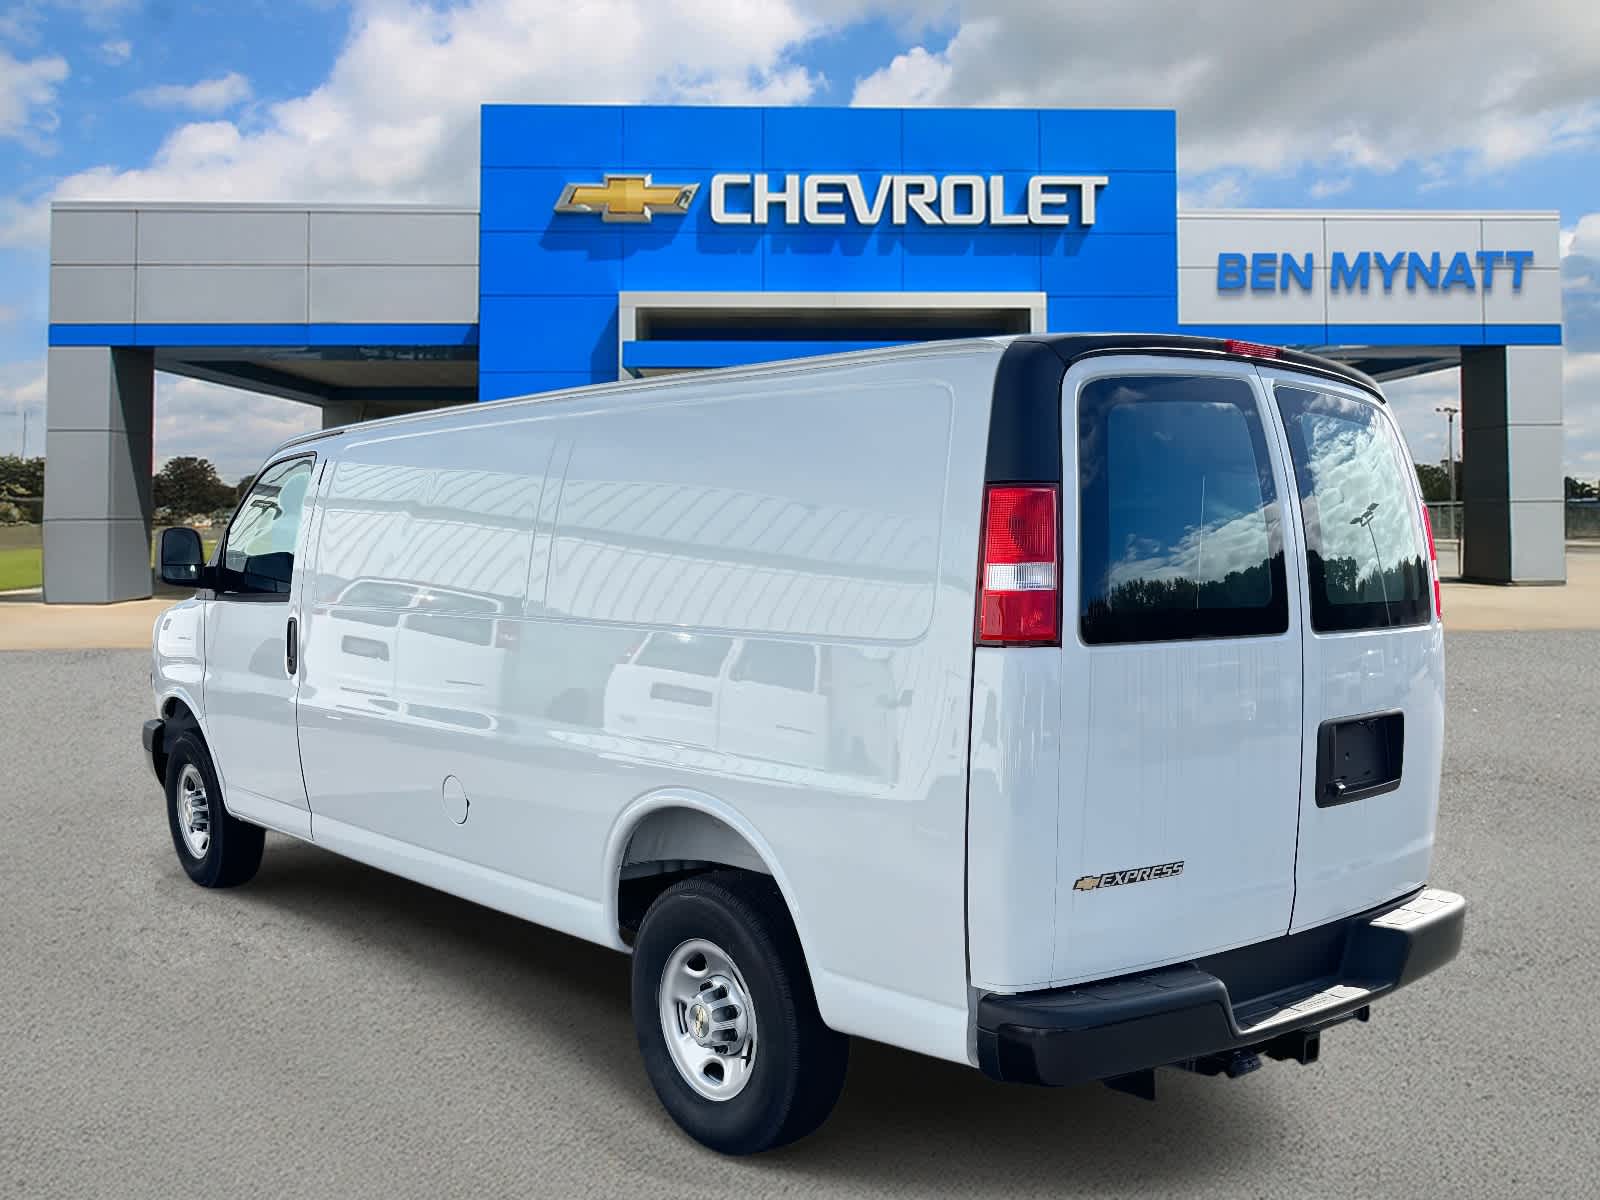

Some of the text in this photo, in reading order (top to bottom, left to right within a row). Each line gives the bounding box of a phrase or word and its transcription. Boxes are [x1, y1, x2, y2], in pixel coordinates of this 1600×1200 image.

[710, 173, 1109, 226] CHEVROLET
[1217, 250, 1534, 290] BEN MYNATT
[1097, 861, 1185, 888] EXPRESS
